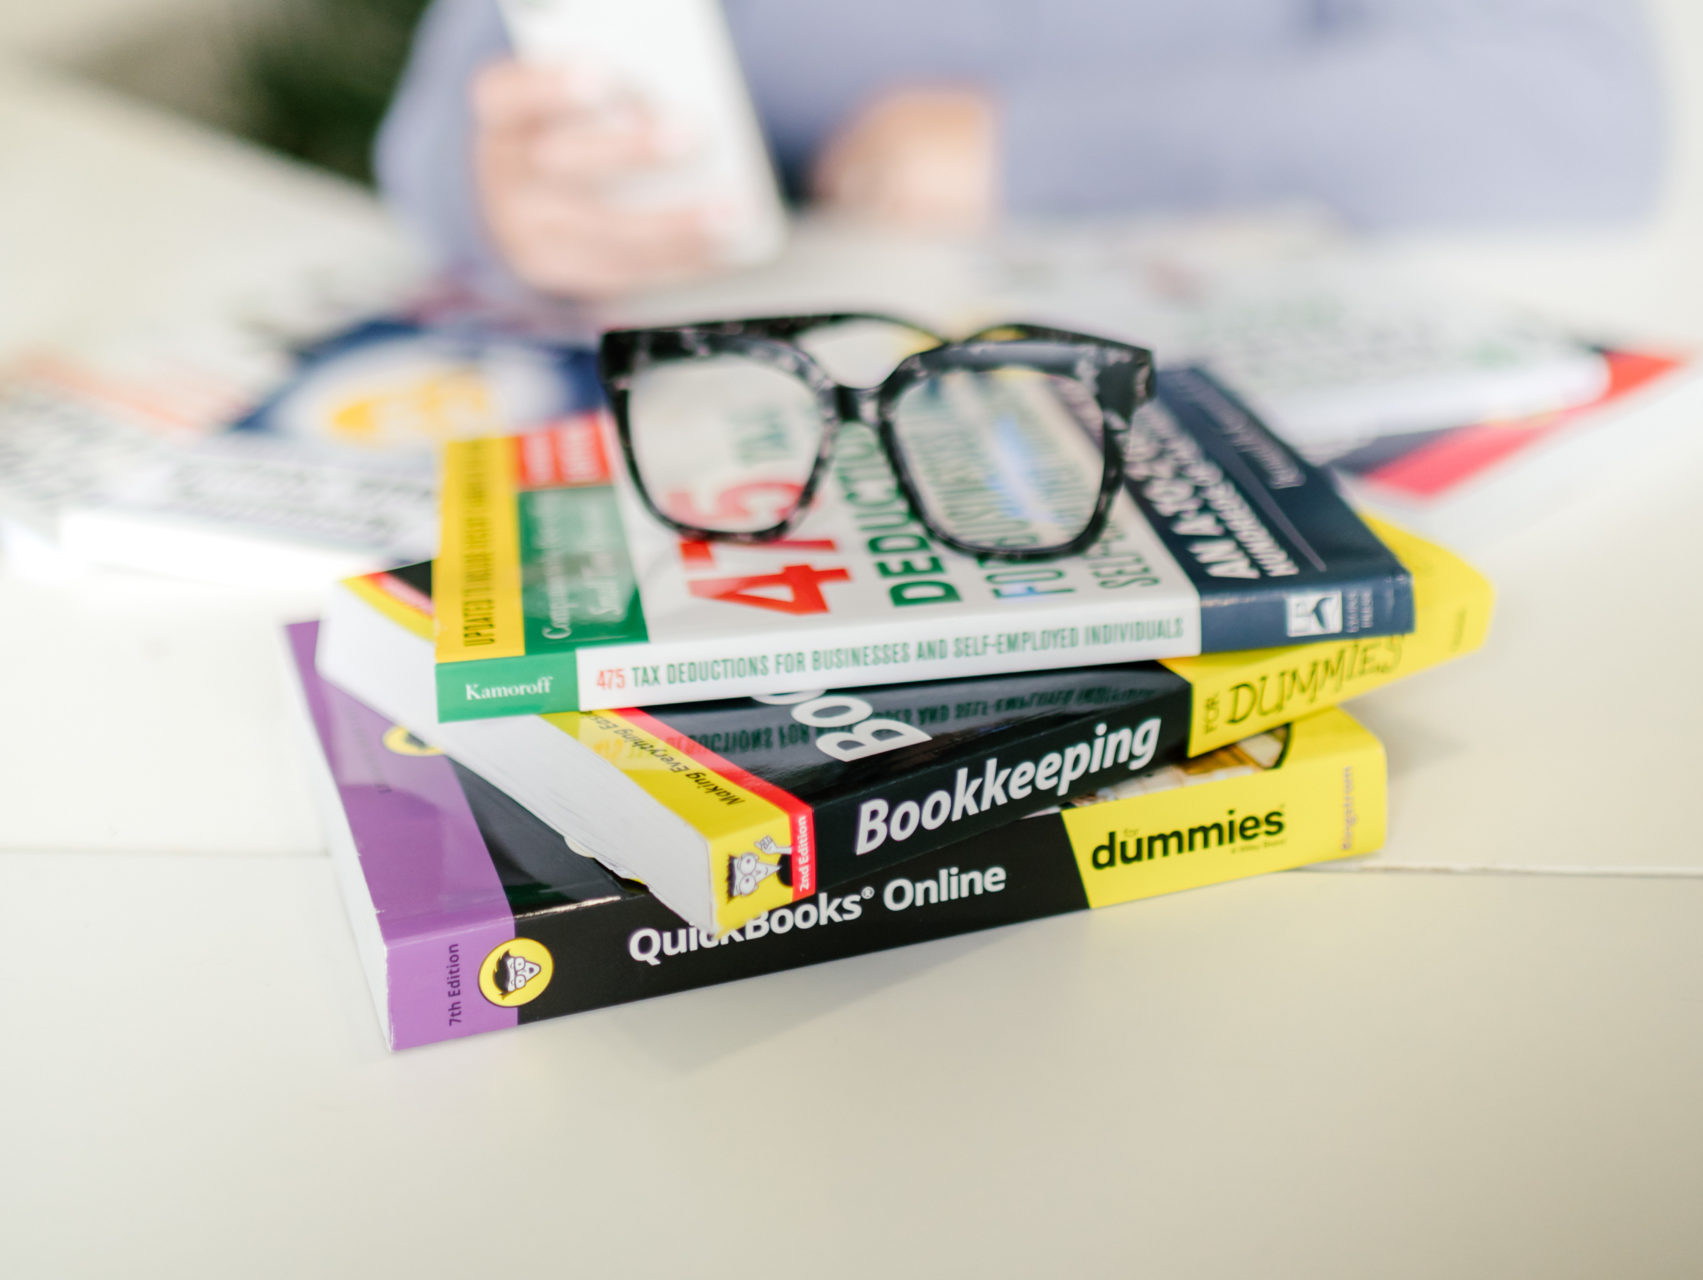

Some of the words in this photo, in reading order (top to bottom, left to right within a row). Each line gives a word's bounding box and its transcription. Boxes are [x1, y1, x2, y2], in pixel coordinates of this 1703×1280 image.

[667, 480, 852, 616] 475
[596, 669, 626, 690] 475
[632, 665, 661, 688] TAX
[667, 656, 769, 685] DEDUCTIONS
[776, 652, 805, 675] FOR
[812, 642, 911, 671] BUSINESSES
[916, 638, 948, 662] AND
[954, 626, 1079, 658] SELF-EMPLOYED
[1085, 617, 1184, 645] INDIVIDUALS
[465, 676, 554, 701] Kamoroff
[1227, 634, 1406, 725] DUMMIES
[617, 727, 690, 775] Everything
[685, 772, 746, 807] Making
[856, 718, 1162, 856] Bookkeeping
[797, 815, 809, 865] Edition
[1091, 809, 1285, 870] dummies
[799, 864, 809, 892] 2nd
[883, 865, 1007, 911] Online
[447, 942, 461, 996] Edition
[449, 1000, 461, 1027] 7th
